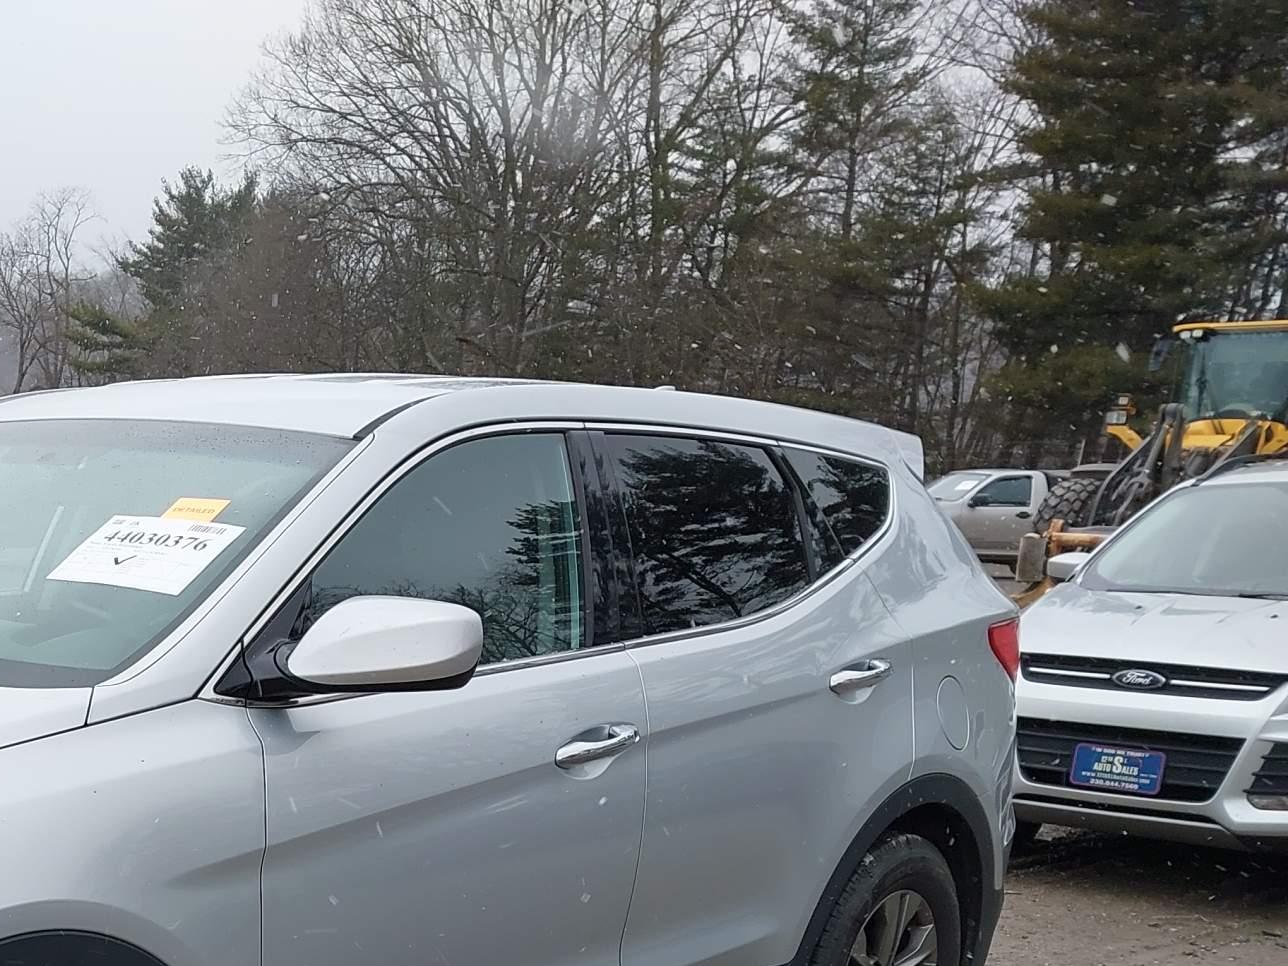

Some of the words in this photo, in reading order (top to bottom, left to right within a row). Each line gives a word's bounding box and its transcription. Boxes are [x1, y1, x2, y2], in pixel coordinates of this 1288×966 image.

[104, 529, 213, 551] 44030376
[1122, 672, 1153, 685] Ford
[1093, 762, 1110, 771] AUTO
[1112, 756, 1138, 775] SALES
